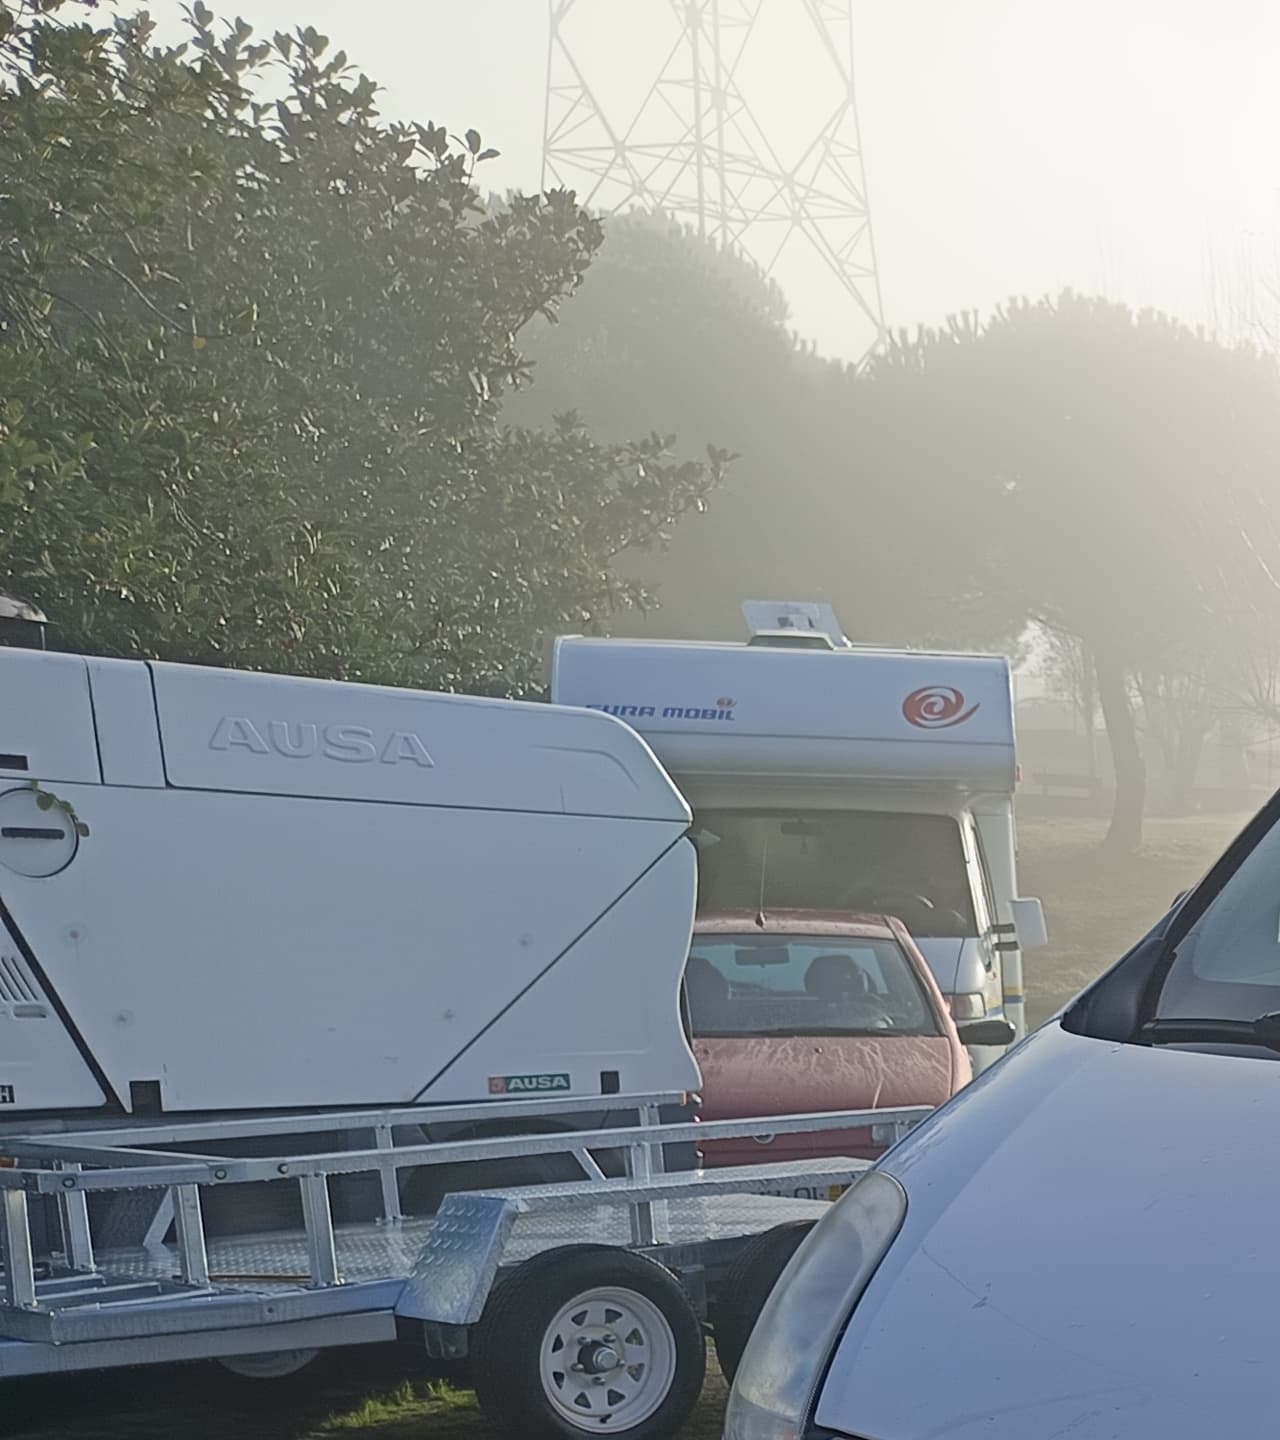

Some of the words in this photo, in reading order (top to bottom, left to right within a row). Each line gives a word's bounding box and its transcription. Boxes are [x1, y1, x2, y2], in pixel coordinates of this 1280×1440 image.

[662, 706, 735, 721] MOBIL
[208, 715, 435, 769] AUSA
[507, 1075, 569, 1091] AUSA
